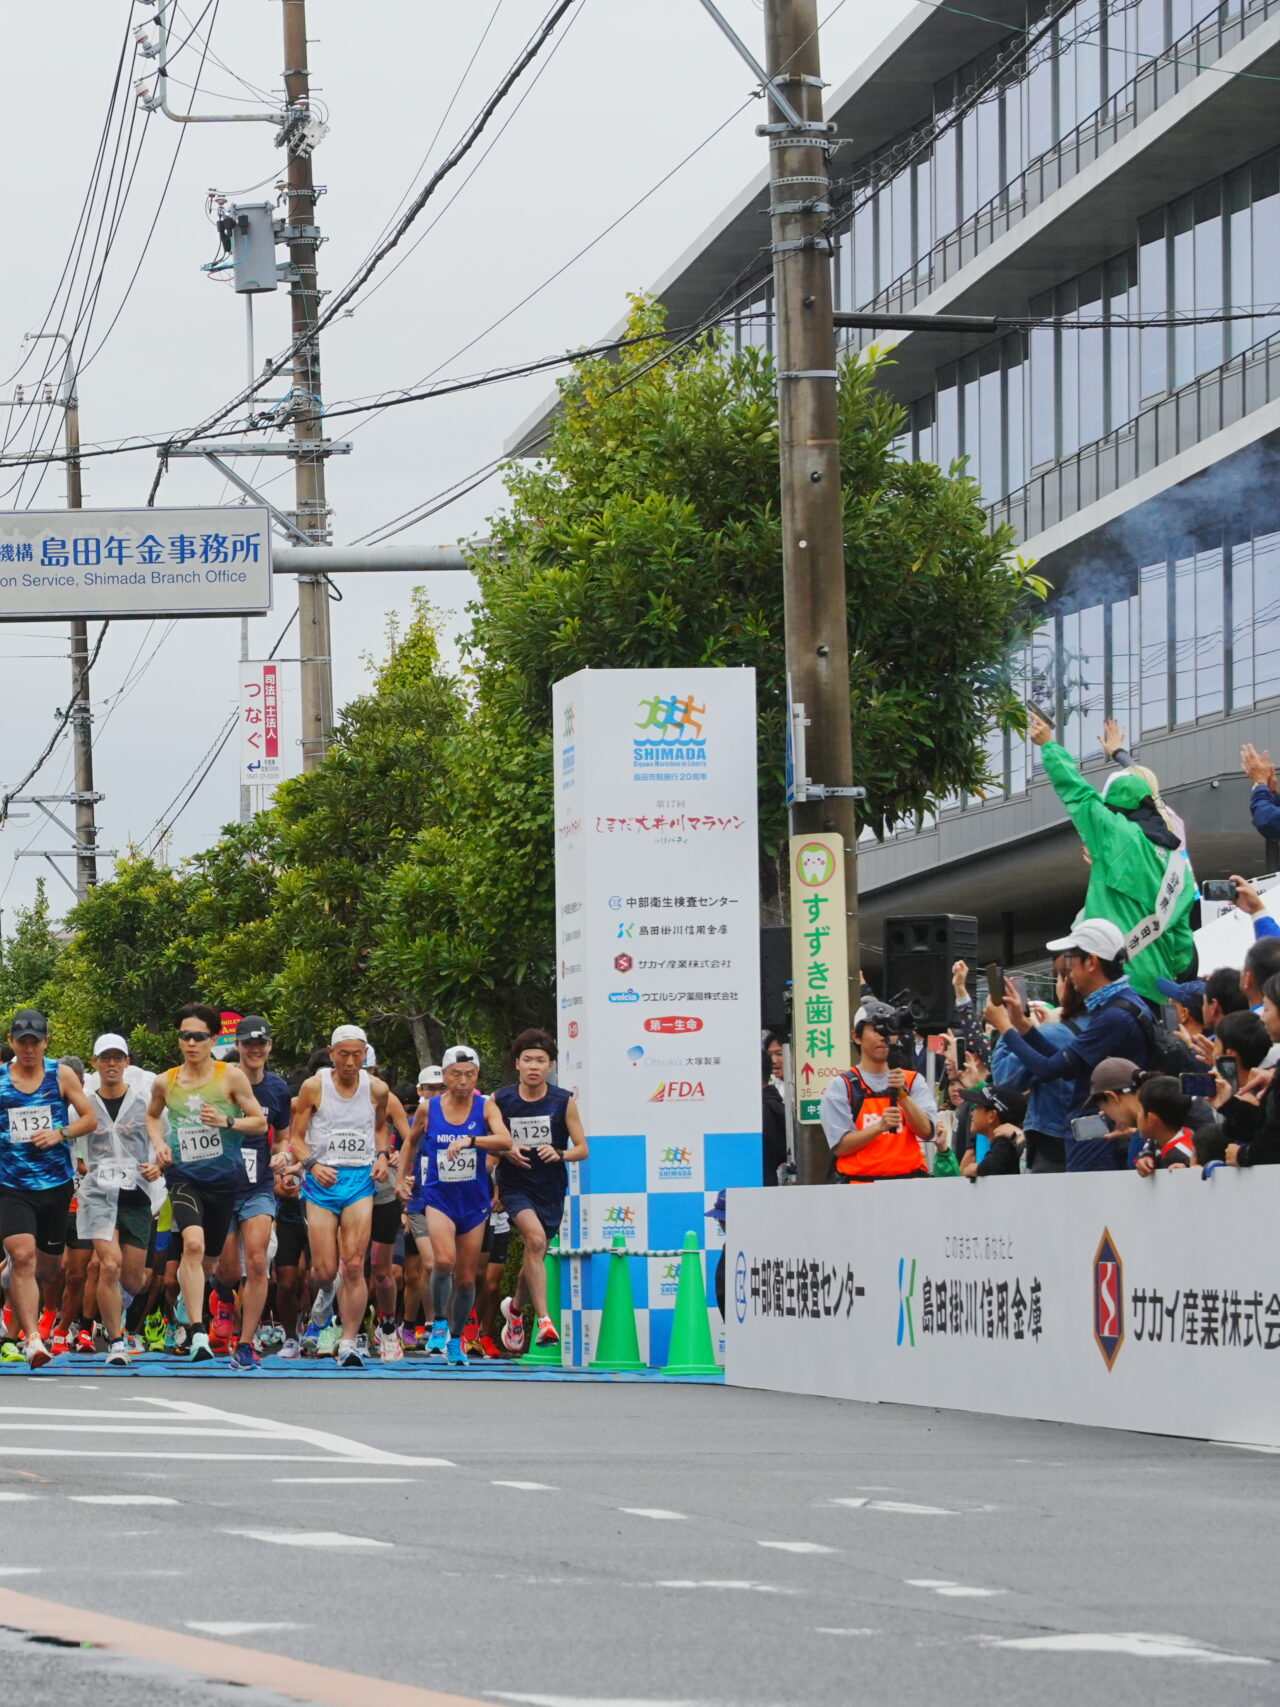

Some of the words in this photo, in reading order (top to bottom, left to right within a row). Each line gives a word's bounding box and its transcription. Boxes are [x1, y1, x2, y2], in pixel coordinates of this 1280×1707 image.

[40, 533, 261, 567] 島田年金事務所
[22, 573, 79, 587] Service,
[84, 572, 146, 586] Shimada
[151, 570, 201, 584] Branch
[205, 569, 247, 583] Office
[244, 683, 262, 749] つなぐ
[634, 747, 707, 760] SHIMADA
[626, 896, 739, 908] 中部衛生検査センター
[638, 924, 728, 936] 島田掛川信用金庫
[638, 959, 731, 969] サカイ産業株式会社
[802, 893, 835, 1059] すずき歯科
[650, 1019, 698, 1031] 第一生命
[685, 1057, 721, 1066] 大塚製薬
[817, 1067, 847, 1077] 600m
[667, 1081, 705, 1097] FDA
[750, 1257, 865, 1320] 中部衛生検査センター
[922, 1276, 1043, 1343] 島田掛川信用金庫
